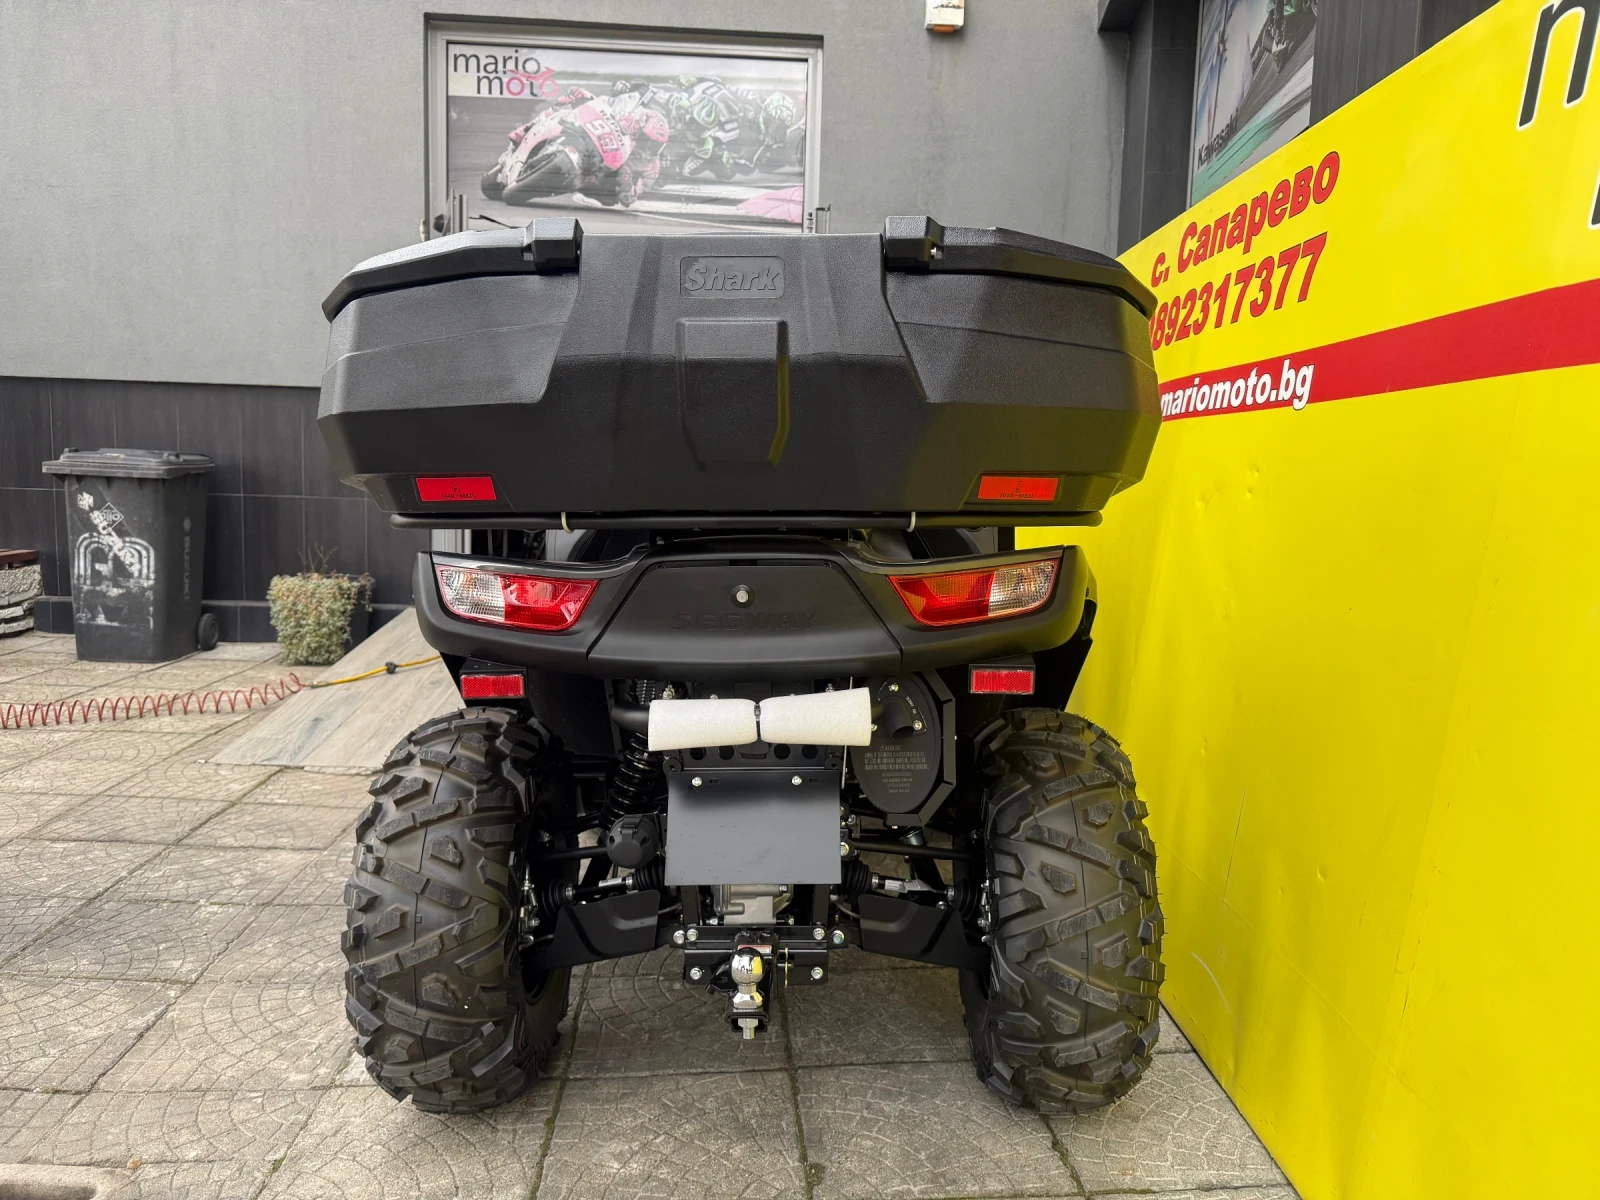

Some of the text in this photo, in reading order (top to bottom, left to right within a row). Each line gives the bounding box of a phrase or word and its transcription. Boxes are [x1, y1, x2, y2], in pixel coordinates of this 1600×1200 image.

[453, 49, 541, 75] mario
[476, 75, 559, 98] moto
[1197, 106, 1239, 170] Kawasaki
[1151, 150, 1340, 288] с. Сапарево
[684, 262, 780, 291] Shark
[1149, 231, 1327, 351] 892317377
[1161, 358, 1315, 411] mariomoto.bg
[671, 611, 817, 631] SEGWAY
